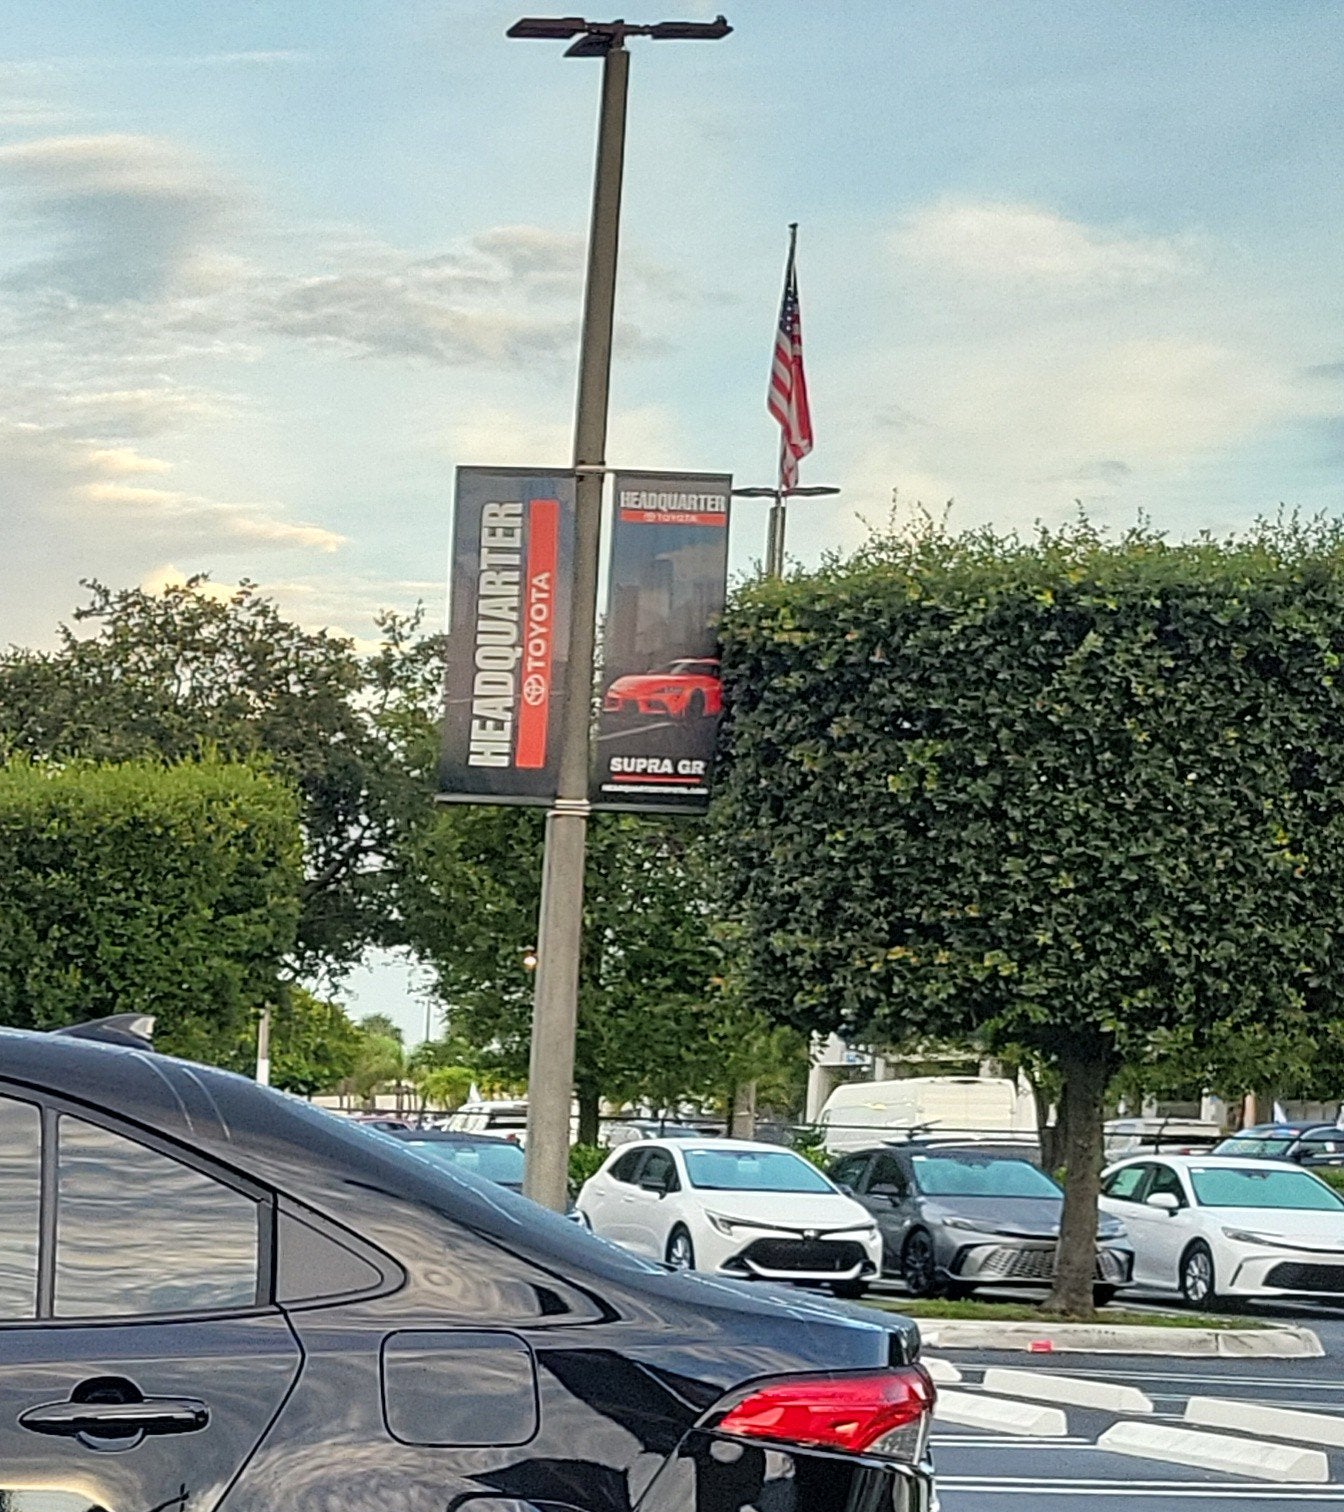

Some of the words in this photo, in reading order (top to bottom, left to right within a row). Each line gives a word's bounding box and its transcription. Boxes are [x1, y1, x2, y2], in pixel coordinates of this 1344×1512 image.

[619, 491, 726, 512] HEADQUARTER
[468, 502, 524, 768] HEADQUARTER
[526, 571, 551, 672] TOYOTA
[610, 757, 673, 774] SUPRA
[677, 759, 706, 775] GR
